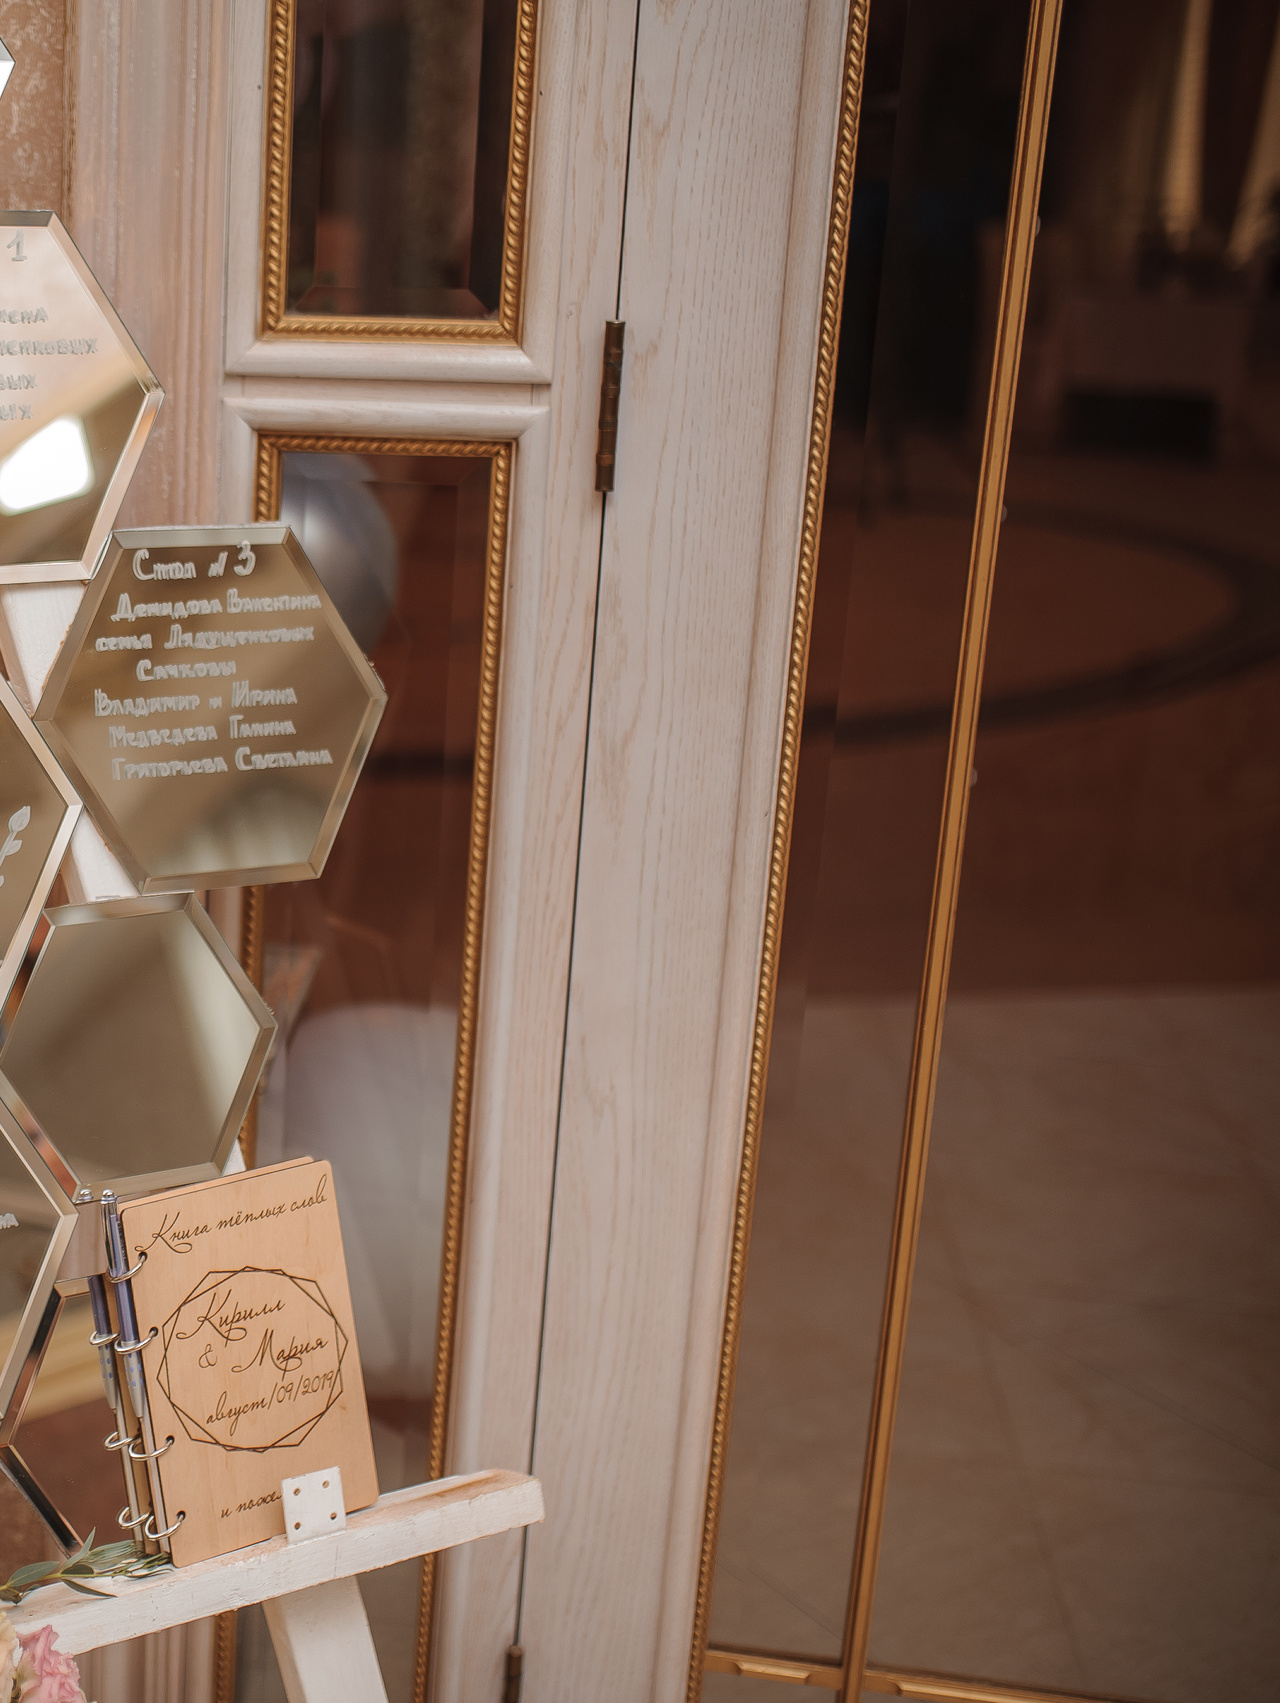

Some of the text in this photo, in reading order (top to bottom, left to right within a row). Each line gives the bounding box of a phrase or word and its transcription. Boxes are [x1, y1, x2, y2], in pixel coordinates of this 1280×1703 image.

[6, 230, 28, 262] 1
[233, 541, 256, 576] 3
[110, 588, 322, 622] Демидова Валентина
[95, 634, 153, 651] семья
[136, 660, 236, 681] Сачковы
[94, 680, 298, 717] Владимир и Ирина
[109, 715, 296, 748] Медведева Галина
[111, 747, 333, 780] Григорьева Светлана
[134, 1211, 213, 1254] Книга
[216, 1203, 286, 1230] тёплых
[290, 1174, 328, 1212] слов
[175, 1289, 286, 1348] Кирилл
[198, 1328, 328, 1382] & Мария
[221, 1508, 232, 1519] и
